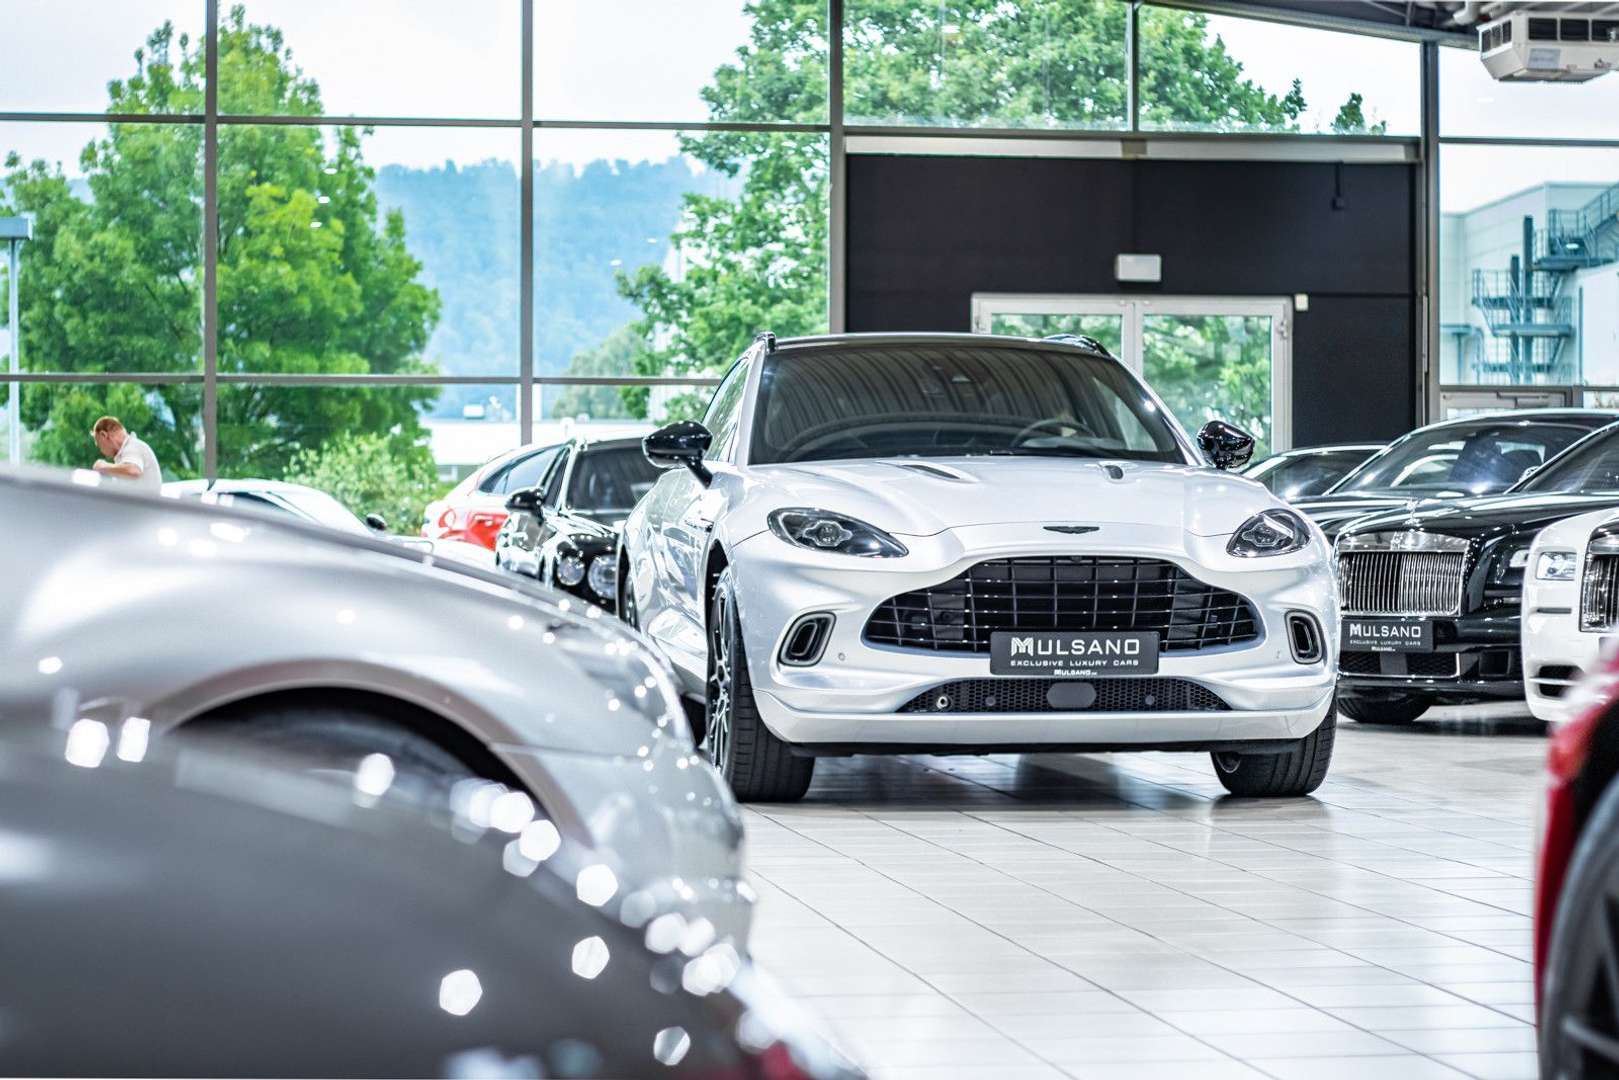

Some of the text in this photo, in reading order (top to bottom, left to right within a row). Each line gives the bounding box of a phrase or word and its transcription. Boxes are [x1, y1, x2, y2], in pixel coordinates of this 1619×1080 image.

[1349, 623, 1421, 638] MULSANO
[1010, 637, 1140, 656] MULSANO
[1010, 659, 1139, 667] EXCLUSIVE LUXURY CARS
